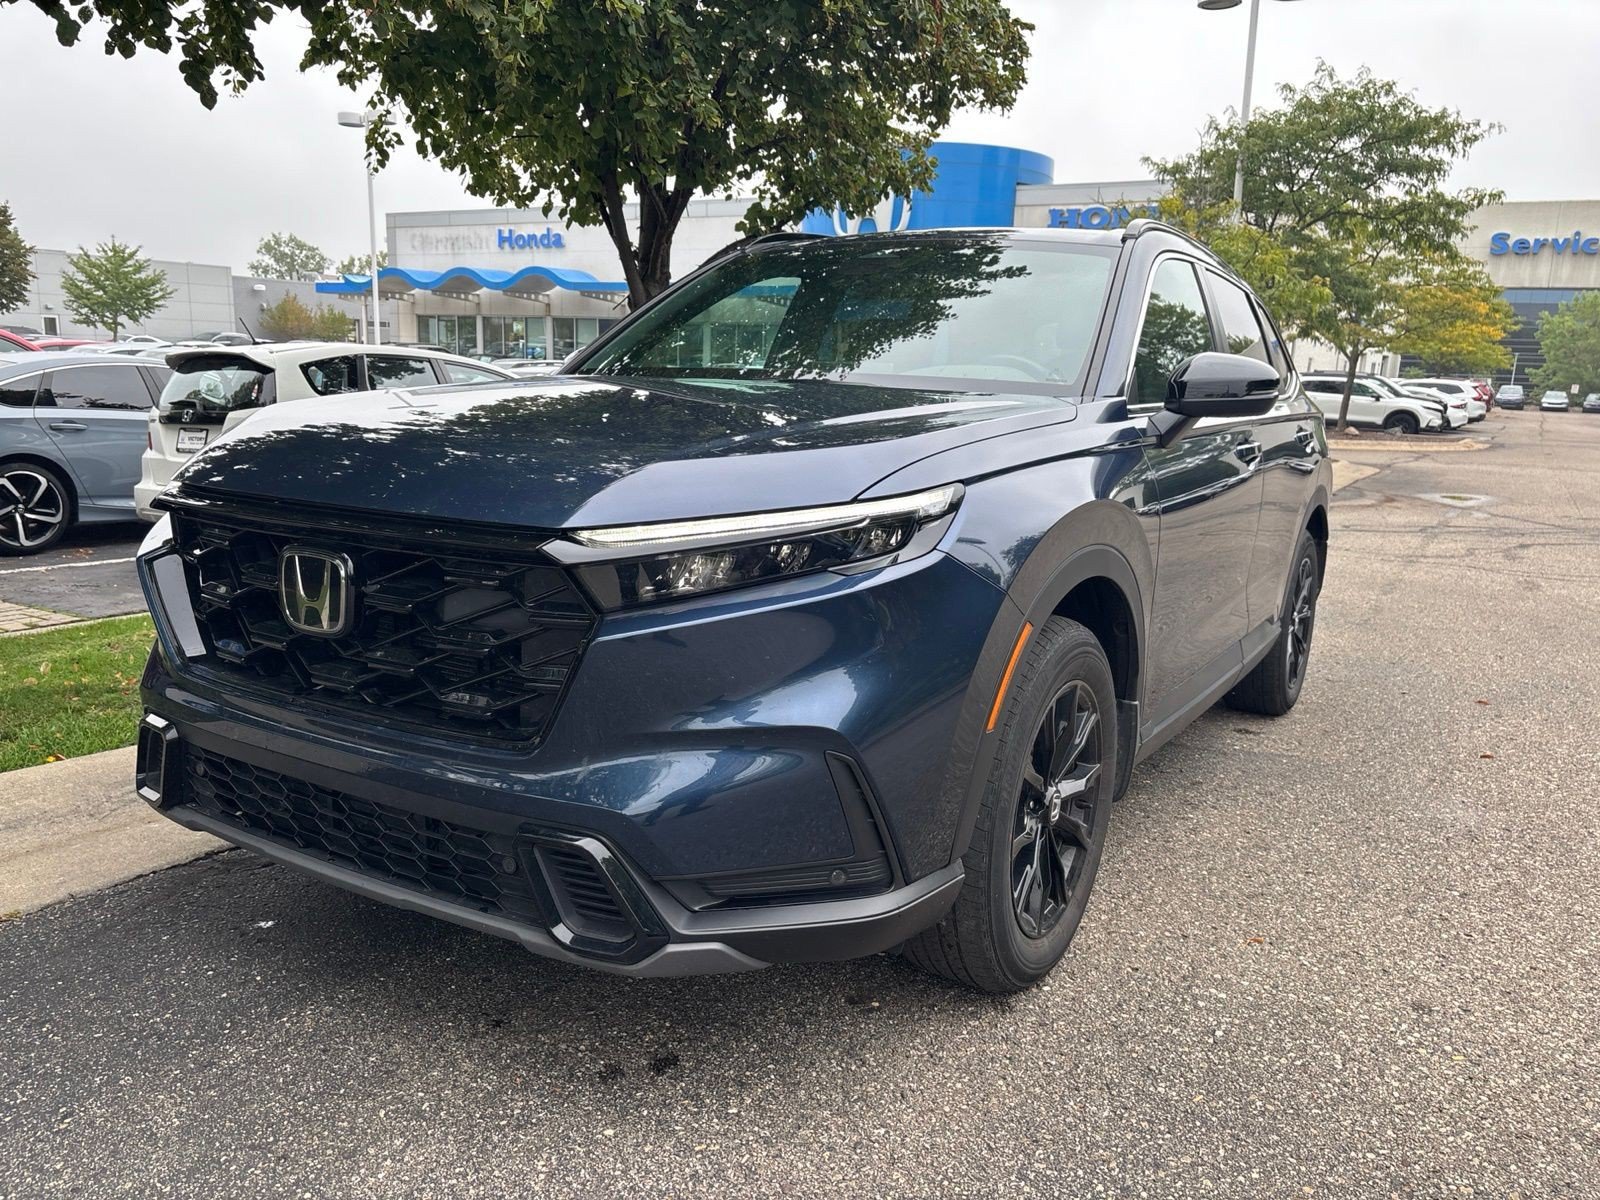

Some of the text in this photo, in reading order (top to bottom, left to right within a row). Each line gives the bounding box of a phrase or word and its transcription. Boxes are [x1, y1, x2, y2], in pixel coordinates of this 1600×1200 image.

[1048, 205, 1161, 229] HON
[497, 227, 565, 249] Honda
[1489, 231, 1600, 255] Servic
